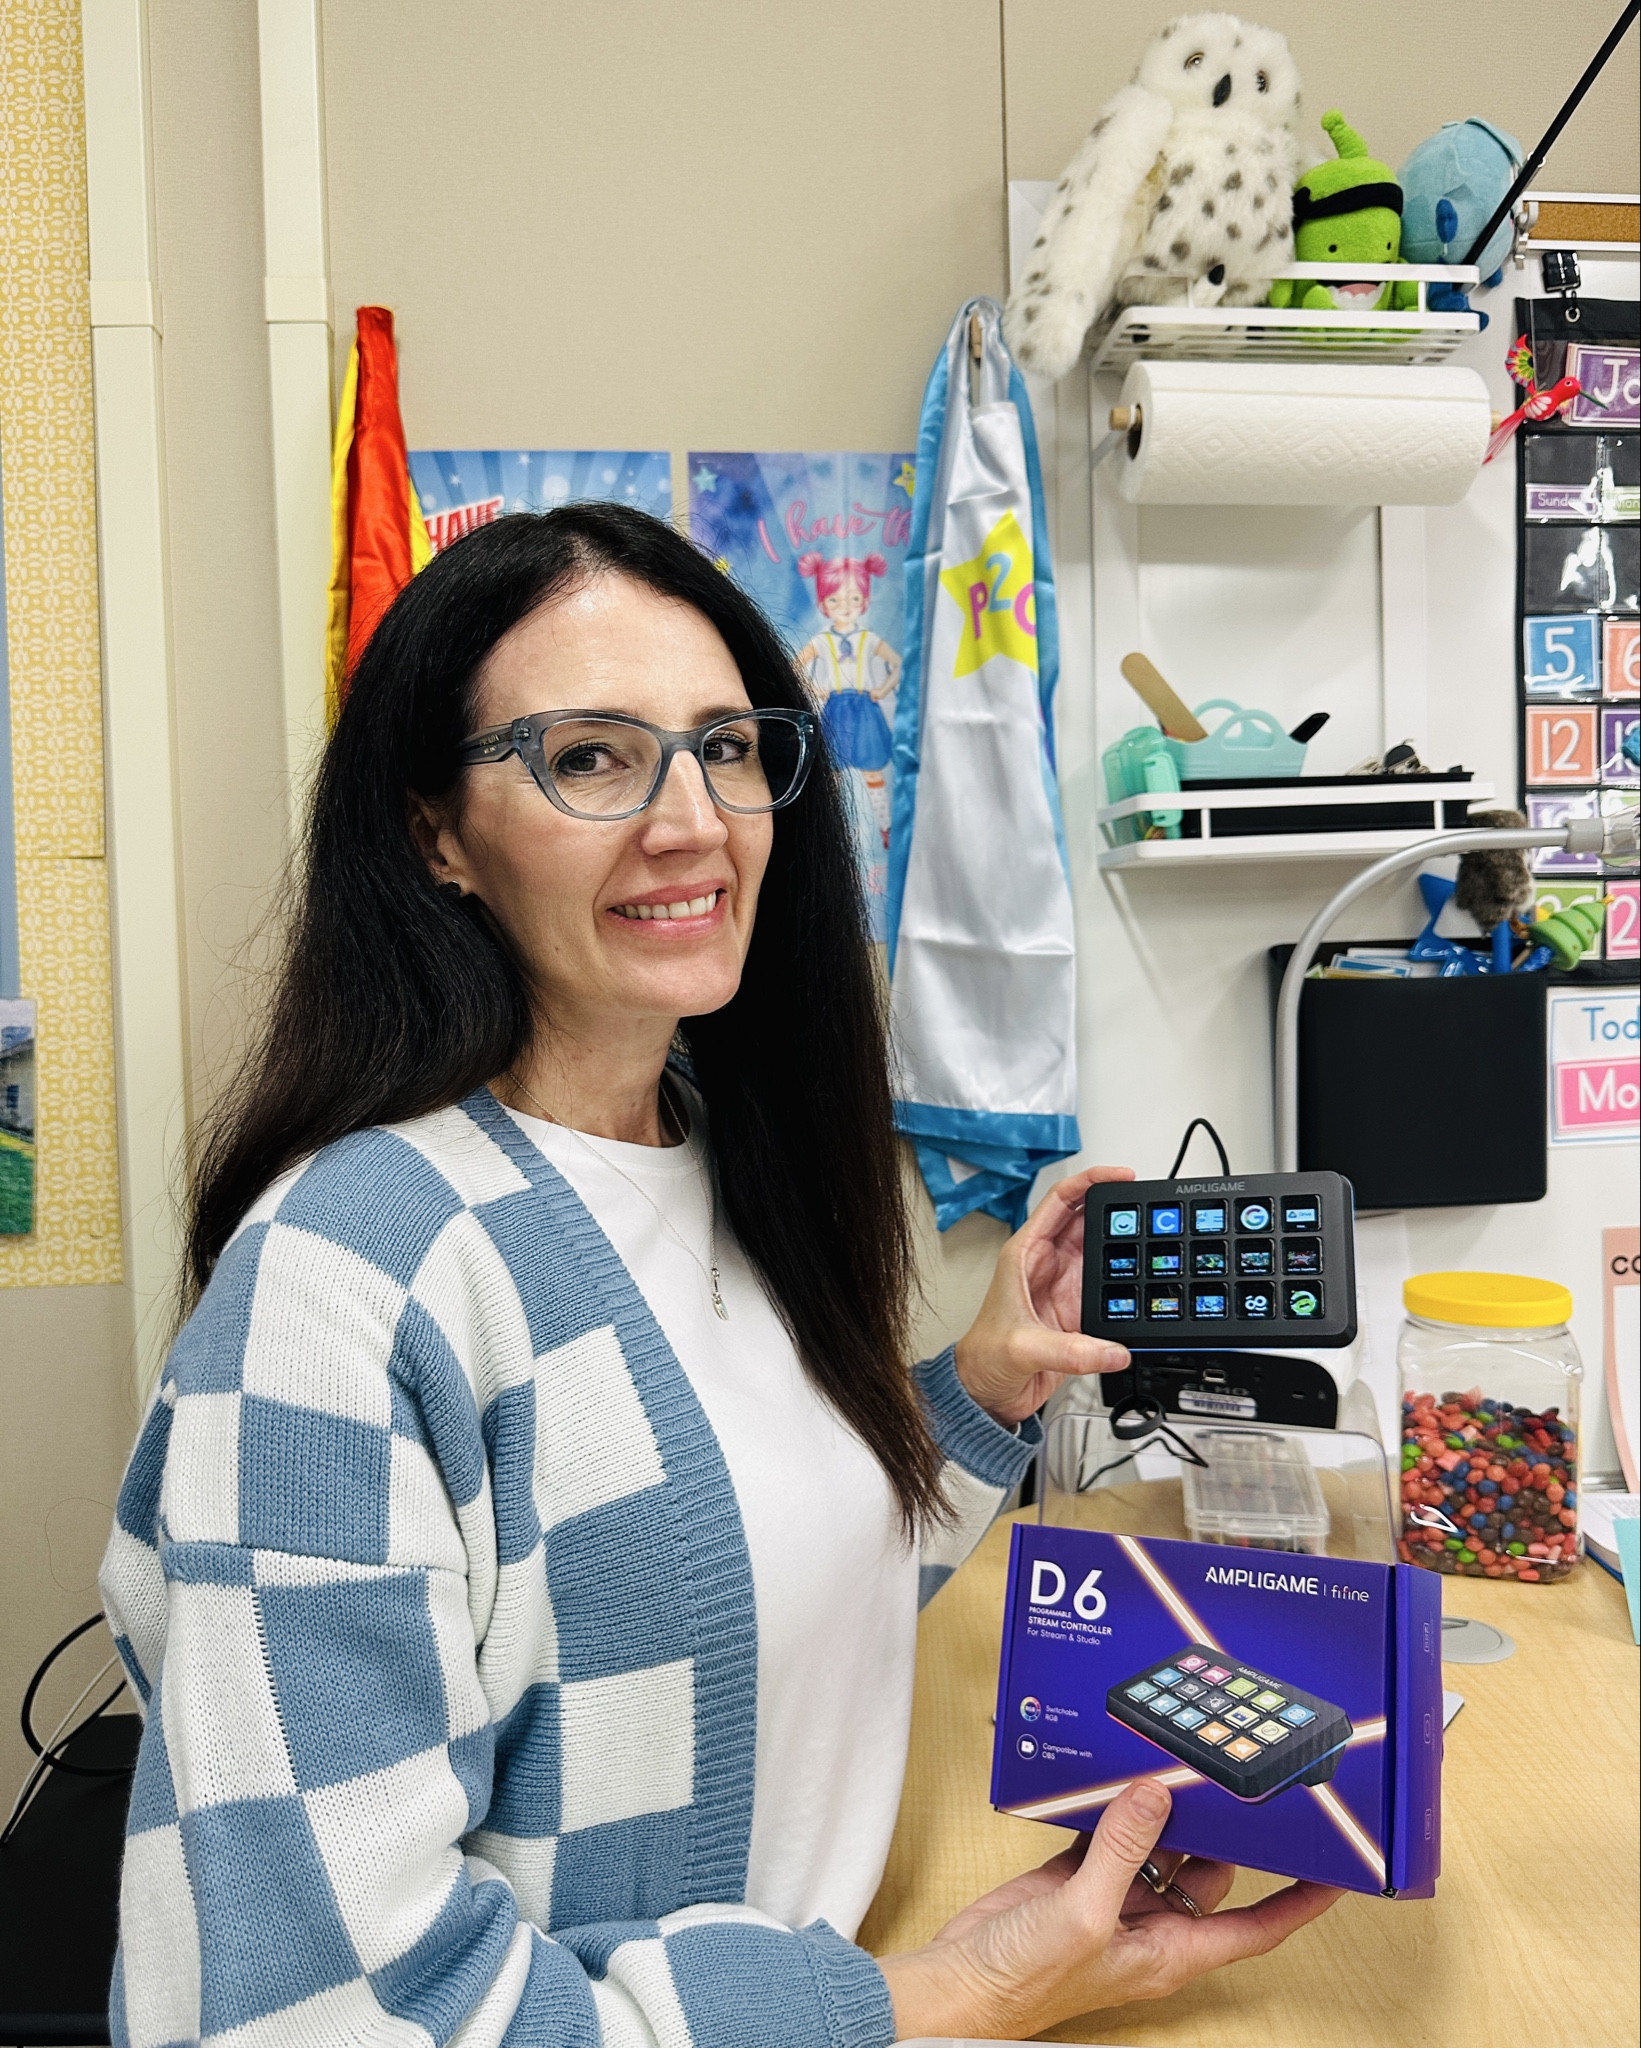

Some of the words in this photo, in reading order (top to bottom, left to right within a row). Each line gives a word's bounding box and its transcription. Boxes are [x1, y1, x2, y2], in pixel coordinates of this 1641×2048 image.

[785, 500, 876, 549] have
[1544, 626, 1576, 681] 5
[1541, 718, 1581, 771] 12
[1581, 1005, 1640, 1042] Tod
[1578, 1067, 1640, 1114] Mo
[1175, 1181, 1246, 1195] AMPLIGAME
[1205, 1566, 1319, 1595] AMPLIGAME
[1331, 1584, 1369, 1602] fifine
[1028, 1606, 1072, 1618] PROGRAMABLE
[1028, 1616, 1059, 1628] STREAM
[1061, 1620, 1112, 1635] CONTROLLER
[1027, 1627, 1039, 1636] For
[1040, 1629, 1067, 1640] Stream
[1068, 1634, 1075, 1642] &
[1076, 1635, 1101, 1645] Studio
[1237, 1666, 1283, 1690] AMPLIGAME
[1044, 1713, 1058, 1722] RGB
[1045, 1704, 1079, 1717] Switchable
[1042, 1742, 1078, 1755] Compatible
[1079, 1750, 1093, 1759] with
[1042, 1751, 1056, 1760] OBS
